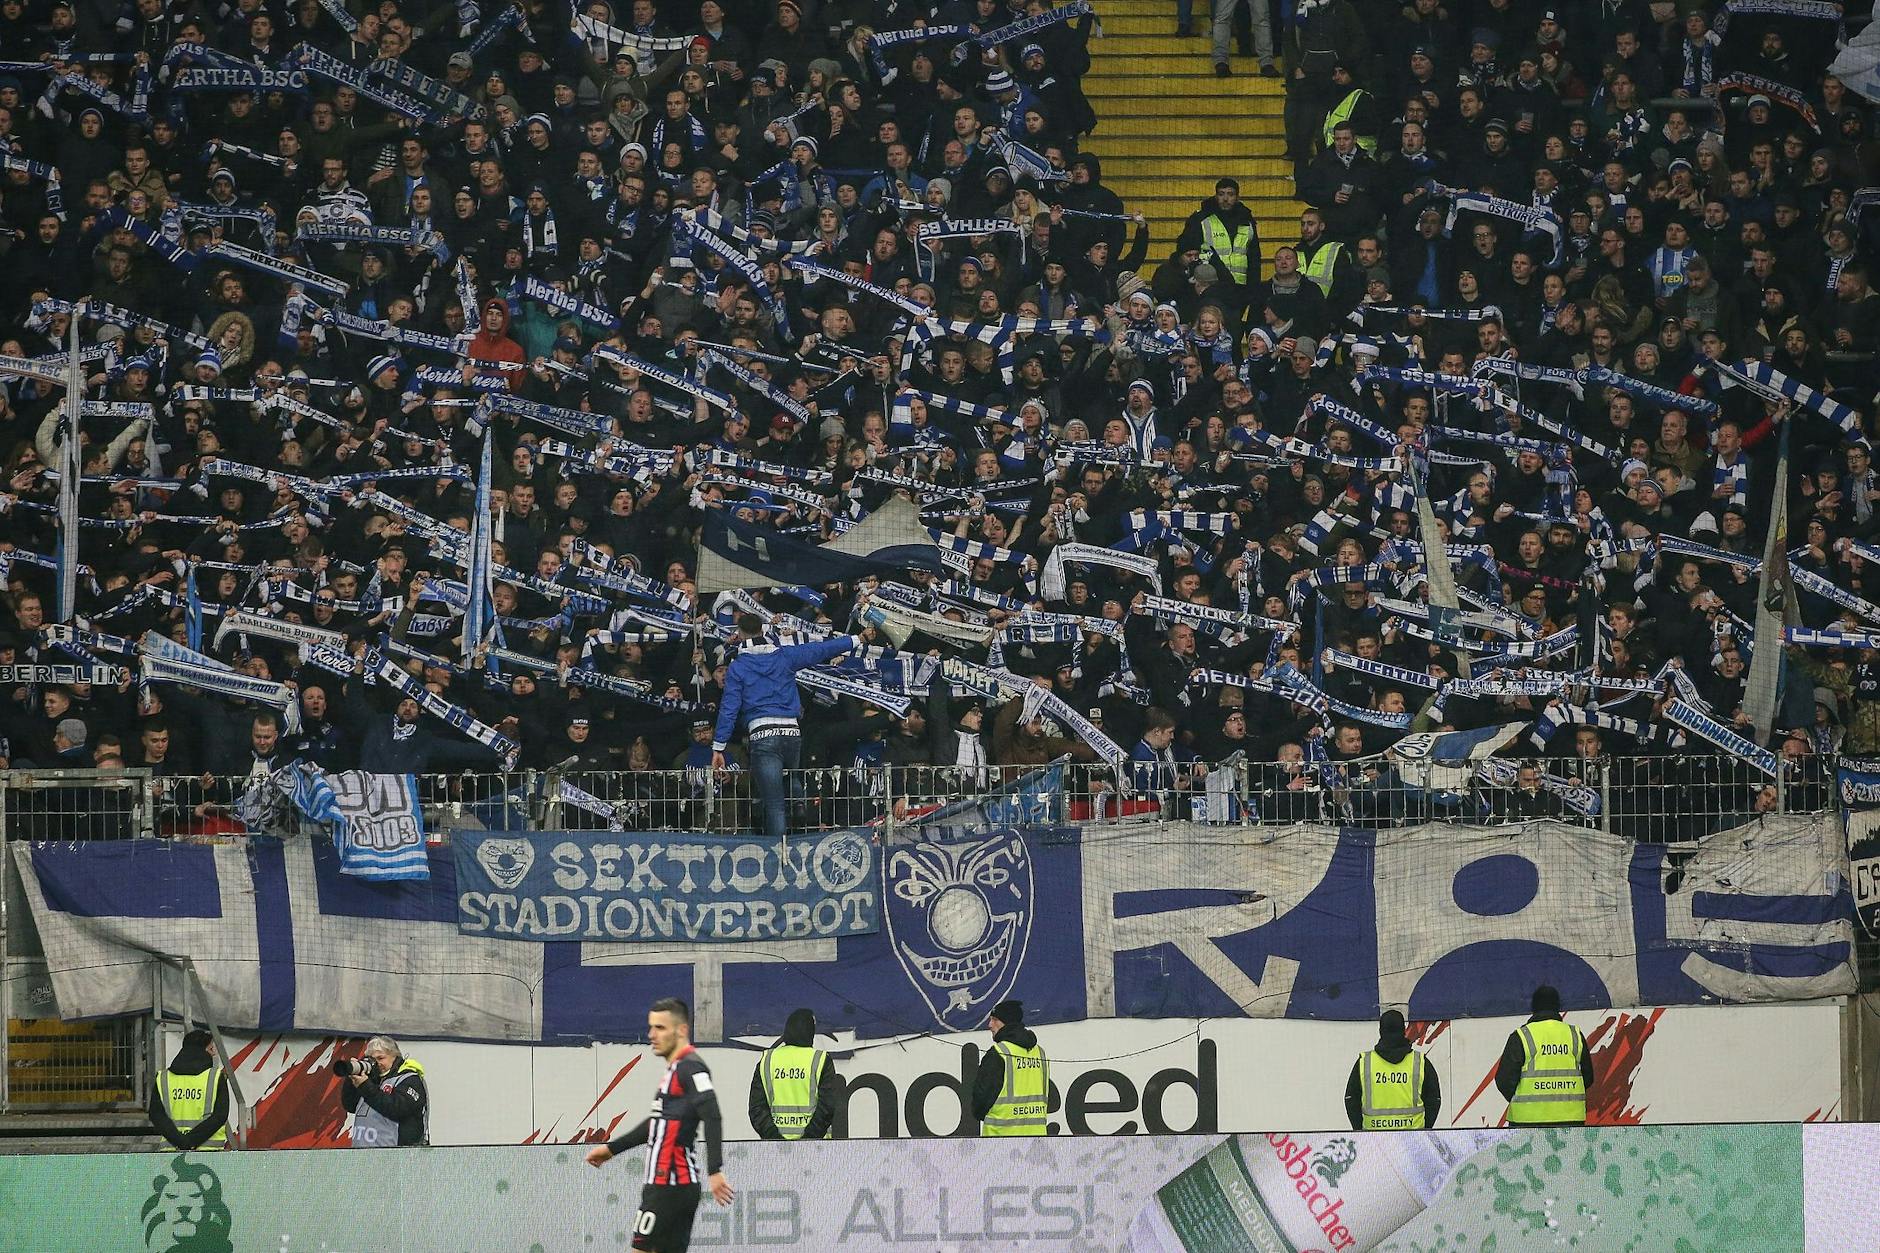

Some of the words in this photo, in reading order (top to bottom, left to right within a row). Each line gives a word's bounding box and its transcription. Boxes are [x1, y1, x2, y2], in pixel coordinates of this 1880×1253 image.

[260, 69, 304, 89] BSC
[1488, 204, 1540, 224] OSTKURVE
[308, 223, 373, 238] HERTHA
[377, 228, 412, 241] BSC
[918, 220, 942, 237] BS
[685, 220, 768, 289] STAMMGAST
[250, 253, 296, 274] HERTHA
[305, 270, 330, 286] BSC
[524, 278, 578, 309] Hertha
[580, 300, 615, 327] BSC
[1400, 369, 1435, 384] BSC
[1315, 397, 1373, 432] Hertha
[1375, 425, 1399, 446] BS
[1146, 595, 1232, 623] SEKTION
[1456, 585, 1533, 631] SENCREW
[239, 615, 291, 634] HARLEKINS
[294, 628, 327, 645] BERLIN
[0, 664, 124, 686] BERLIN
[1357, 659, 1432, 687] HERTHA
[1525, 669, 1575, 685] GEGEN
[1590, 676, 1657, 691] GERADE
[365, 649, 514, 756] BERLIN
[1088, 730, 1119, 759] BERLIN
[550, 841, 814, 892] SEKTION
[458, 891, 873, 939] STADIONVERBOT
[1541, 1044, 1569, 1056] 20040
[774, 1067, 806, 1079] 26-036
[1375, 1071, 1408, 1084] 26-020
[1534, 1080, 1578, 1091] SECURITY
[172, 1088, 202, 1101] 32-005
[831, 1039, 1218, 1139] nded
[1012, 1105, 1047, 1116] SECURIT
[1370, 1117, 1415, 1128] SECURITY
[1265, 1133, 1357, 1253] osbacher
[633, 1209, 657, 1237] 10
[688, 1189, 799, 1247] GIB
[837, 1185, 1096, 1245] ALLES!
